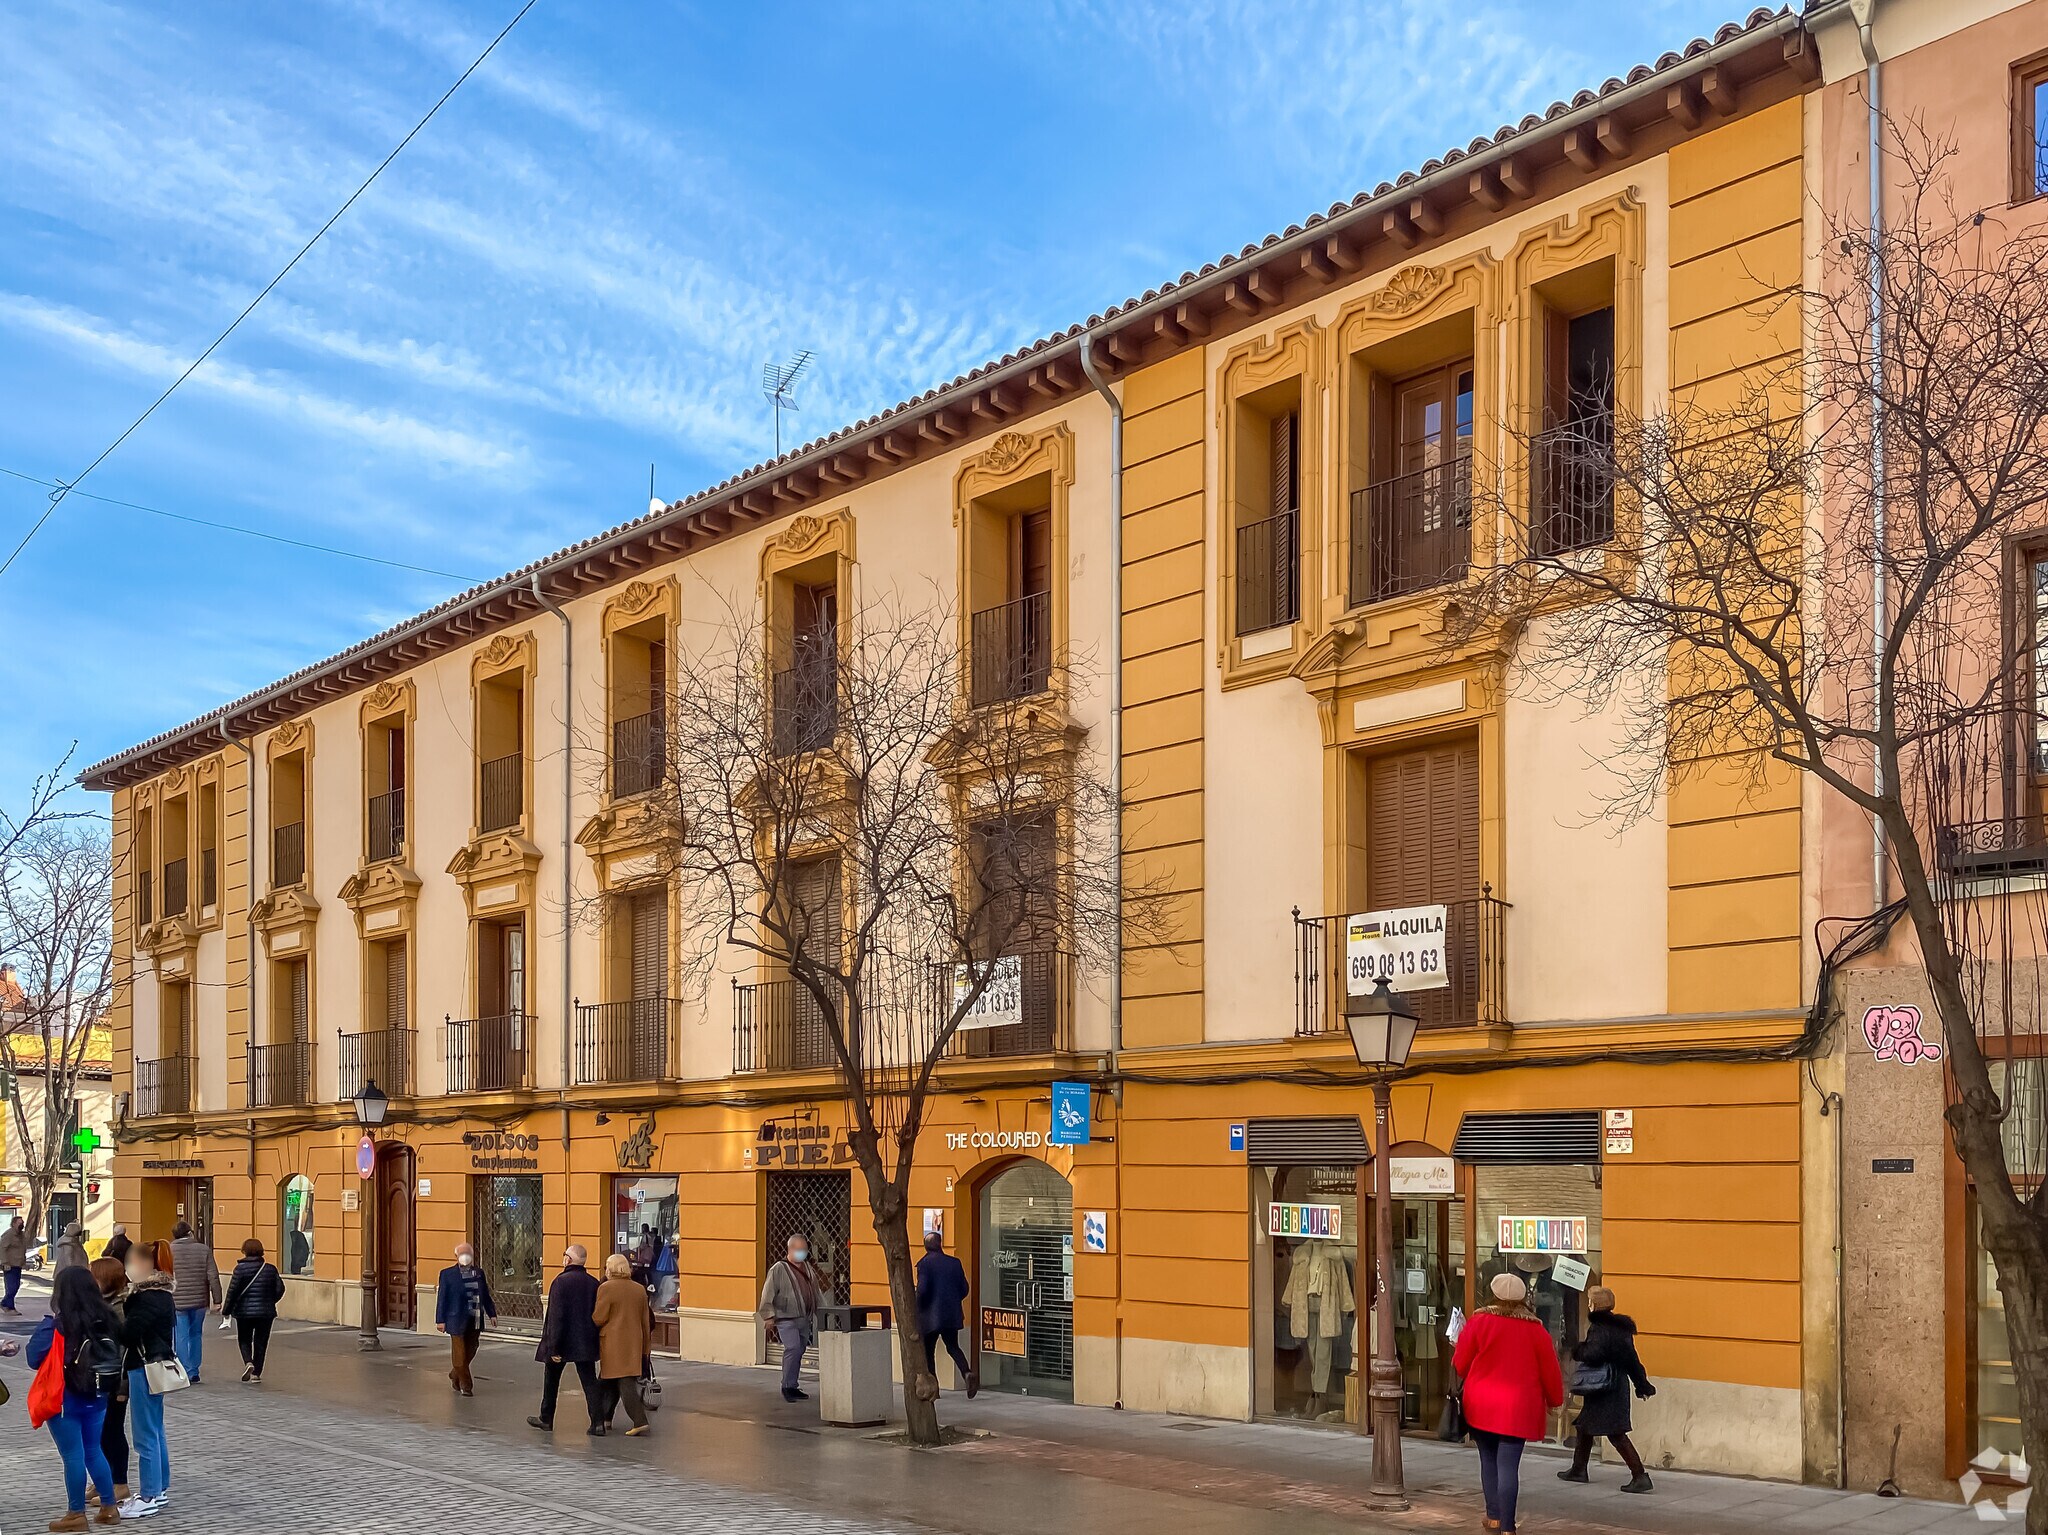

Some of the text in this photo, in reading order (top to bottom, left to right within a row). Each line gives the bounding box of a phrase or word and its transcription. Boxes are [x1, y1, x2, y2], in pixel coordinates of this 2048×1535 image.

[1383, 917, 1443, 937] ALQUILA
[1352, 949, 1438, 979] 699 08 13 63
[990, 994, 1001, 1012] 13
[1004, 991, 1016, 1011] 63
[471, 1134, 539, 1151] BOLSOS
[945, 1133, 968, 1150] THE
[970, 1131, 1042, 1149] COLOURED
[472, 1155, 538, 1170] Complementos
[755, 1142, 857, 1165] PIEL
[1272, 1206, 1338, 1235] REBAJAS
[1503, 1222, 1582, 1248] REBAJAS
[983, 1310, 1024, 1328] SE ALQUILA
